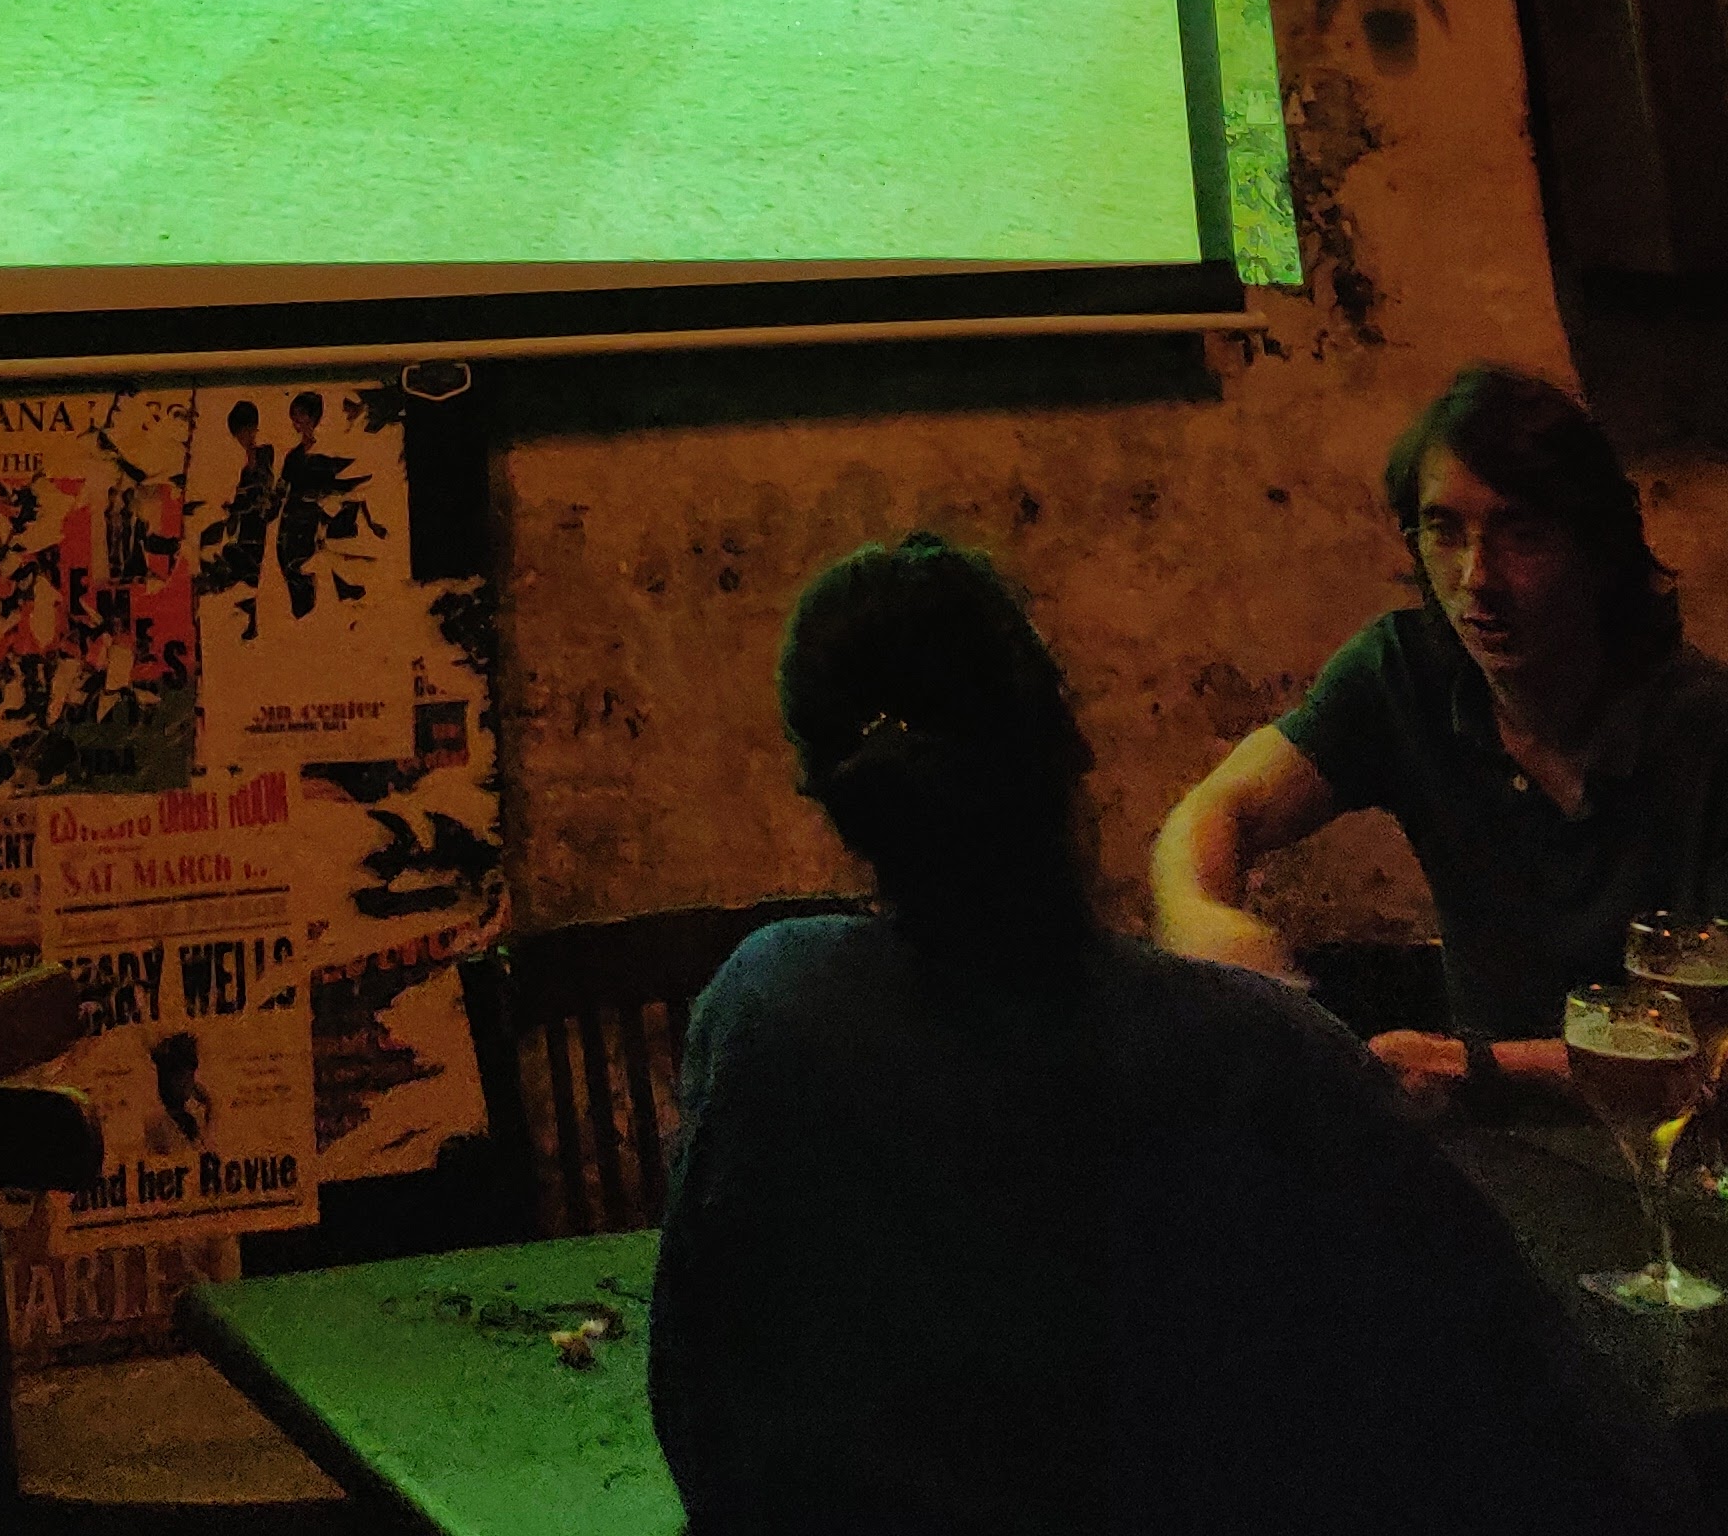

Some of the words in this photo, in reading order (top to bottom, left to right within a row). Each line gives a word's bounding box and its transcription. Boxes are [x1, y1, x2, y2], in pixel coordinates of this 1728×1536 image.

[133, 853, 233, 888] MARCH
[136, 1159, 191, 1205] her
[198, 1151, 298, 1197] Revue
